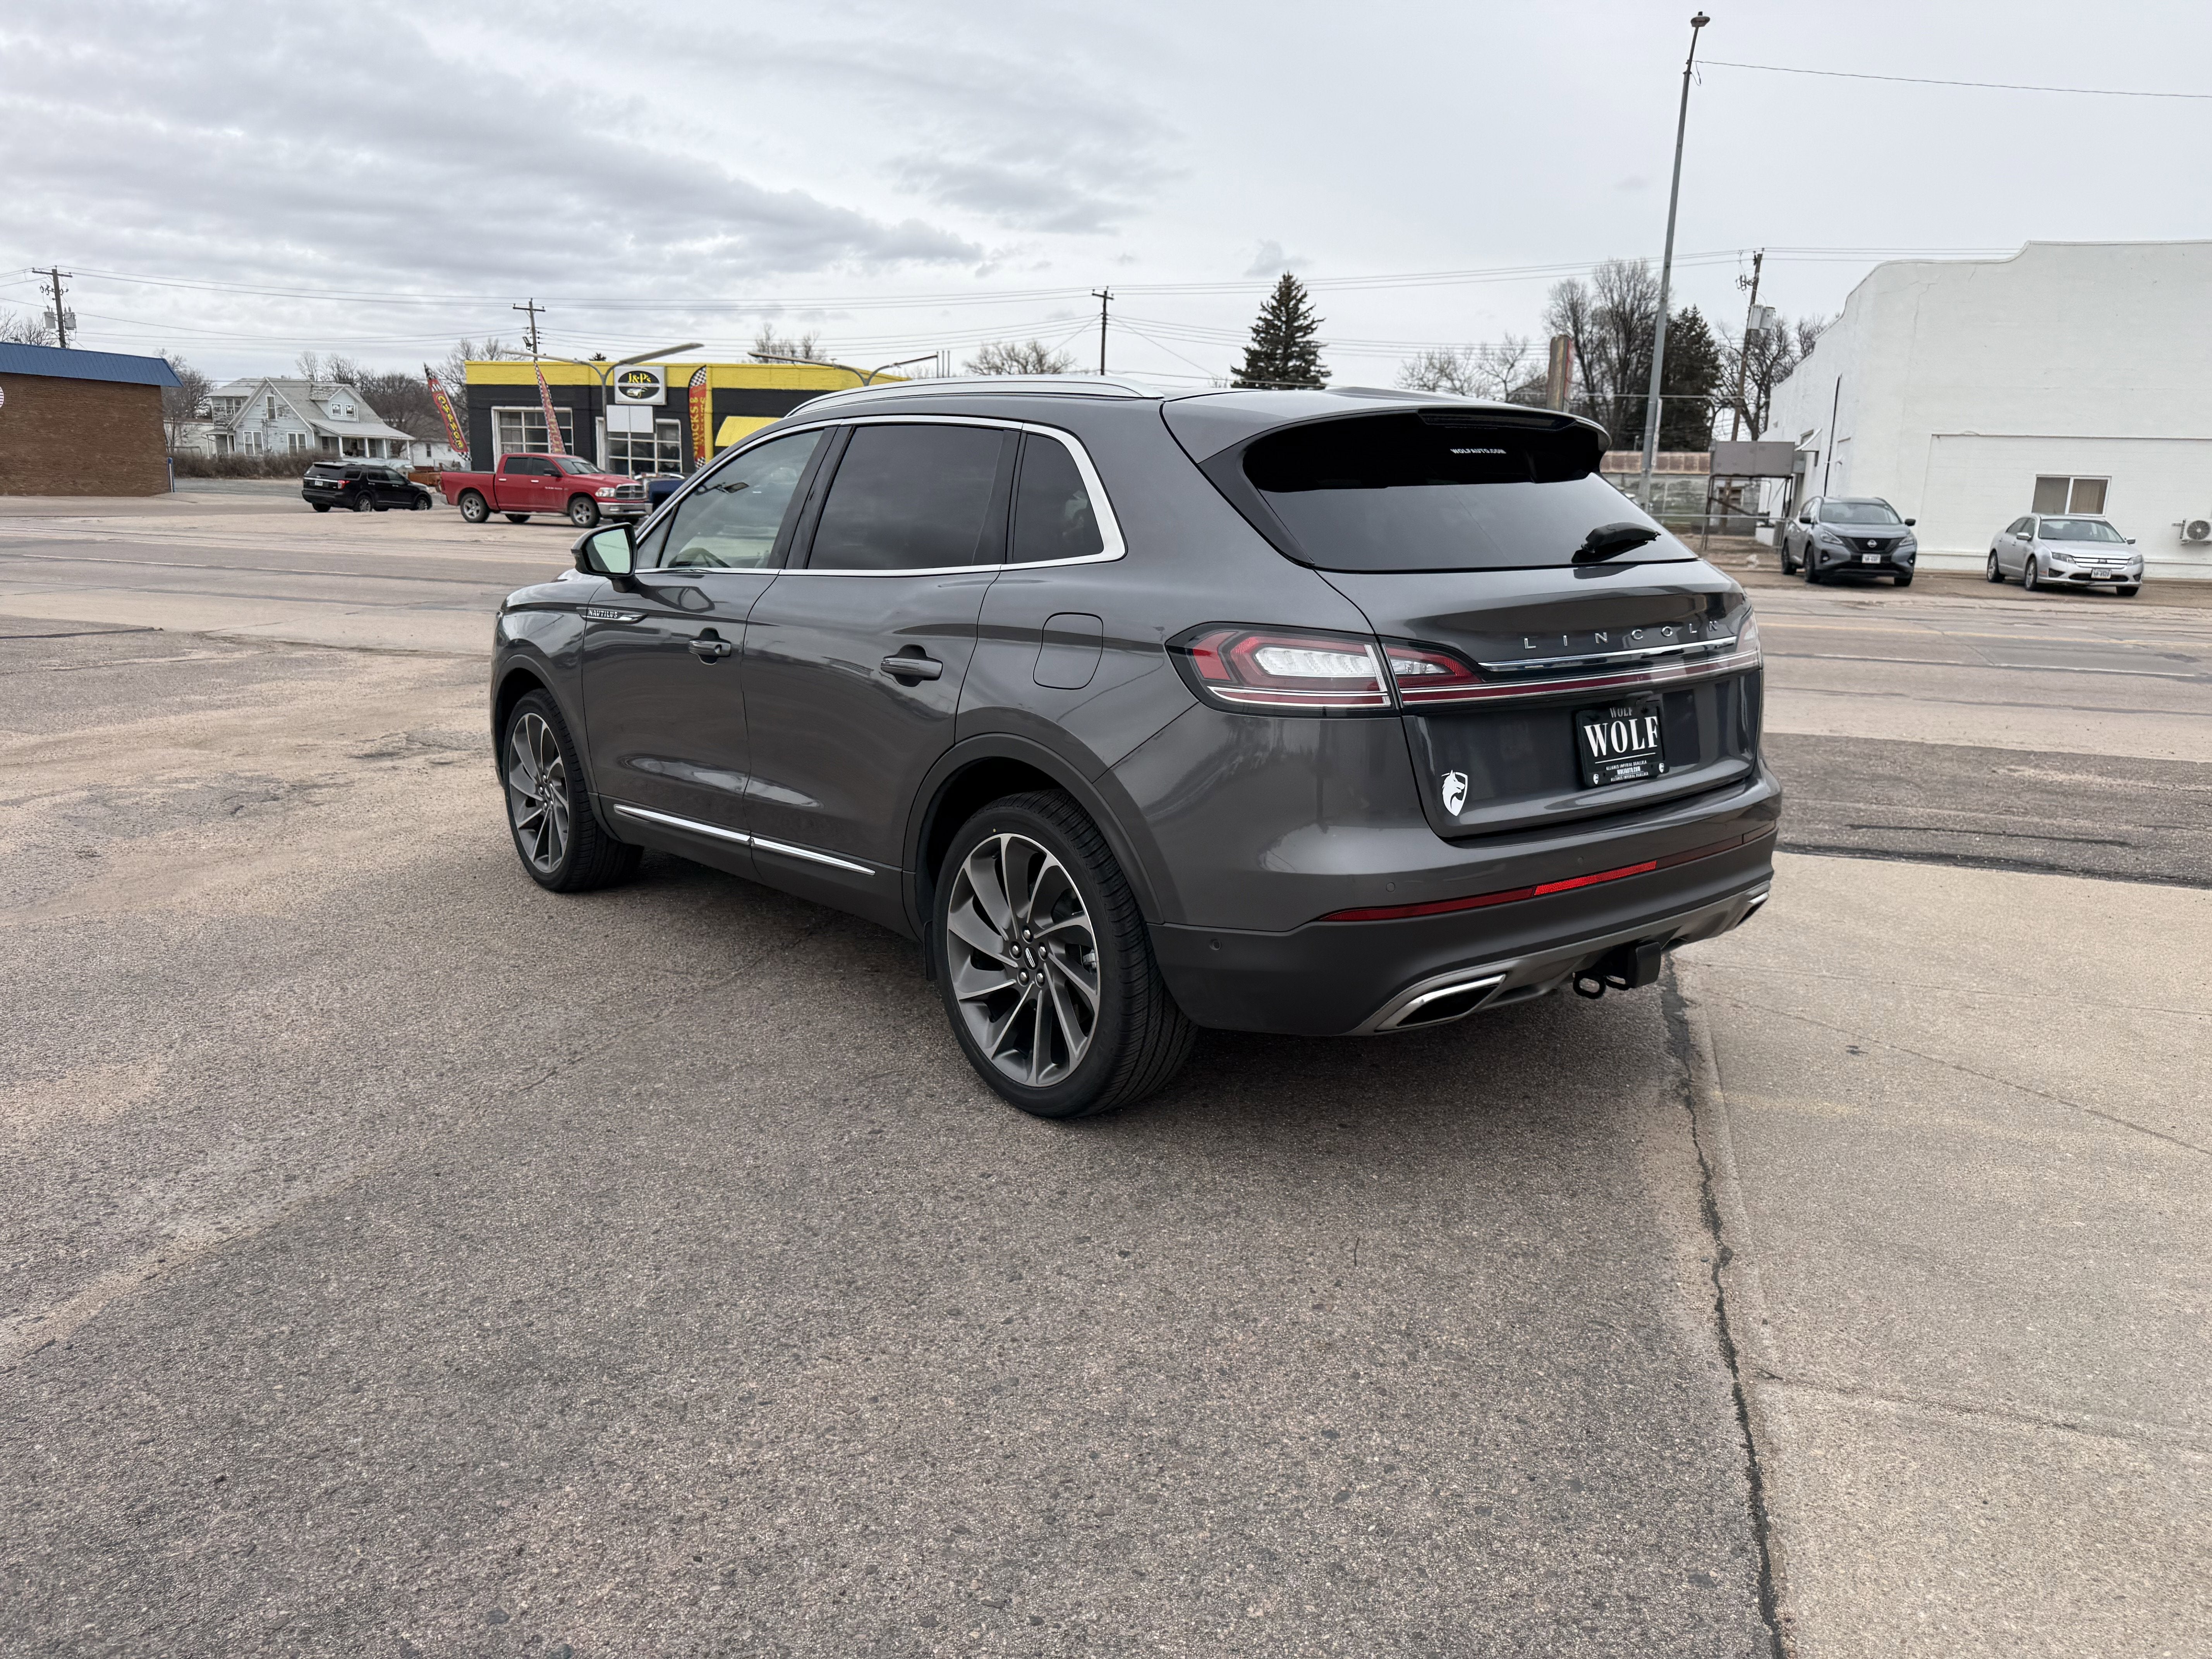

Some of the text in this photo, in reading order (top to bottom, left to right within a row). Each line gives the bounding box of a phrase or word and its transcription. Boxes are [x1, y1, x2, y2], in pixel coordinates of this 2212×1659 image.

[628, 373, 651, 383] J&P's
[589, 610, 618, 618] NAUTILUS
[1524, 621, 1717, 649] LINCOLN
[1609, 706, 1632, 718] WOLF
[1583, 716, 1658, 757] WOLF
